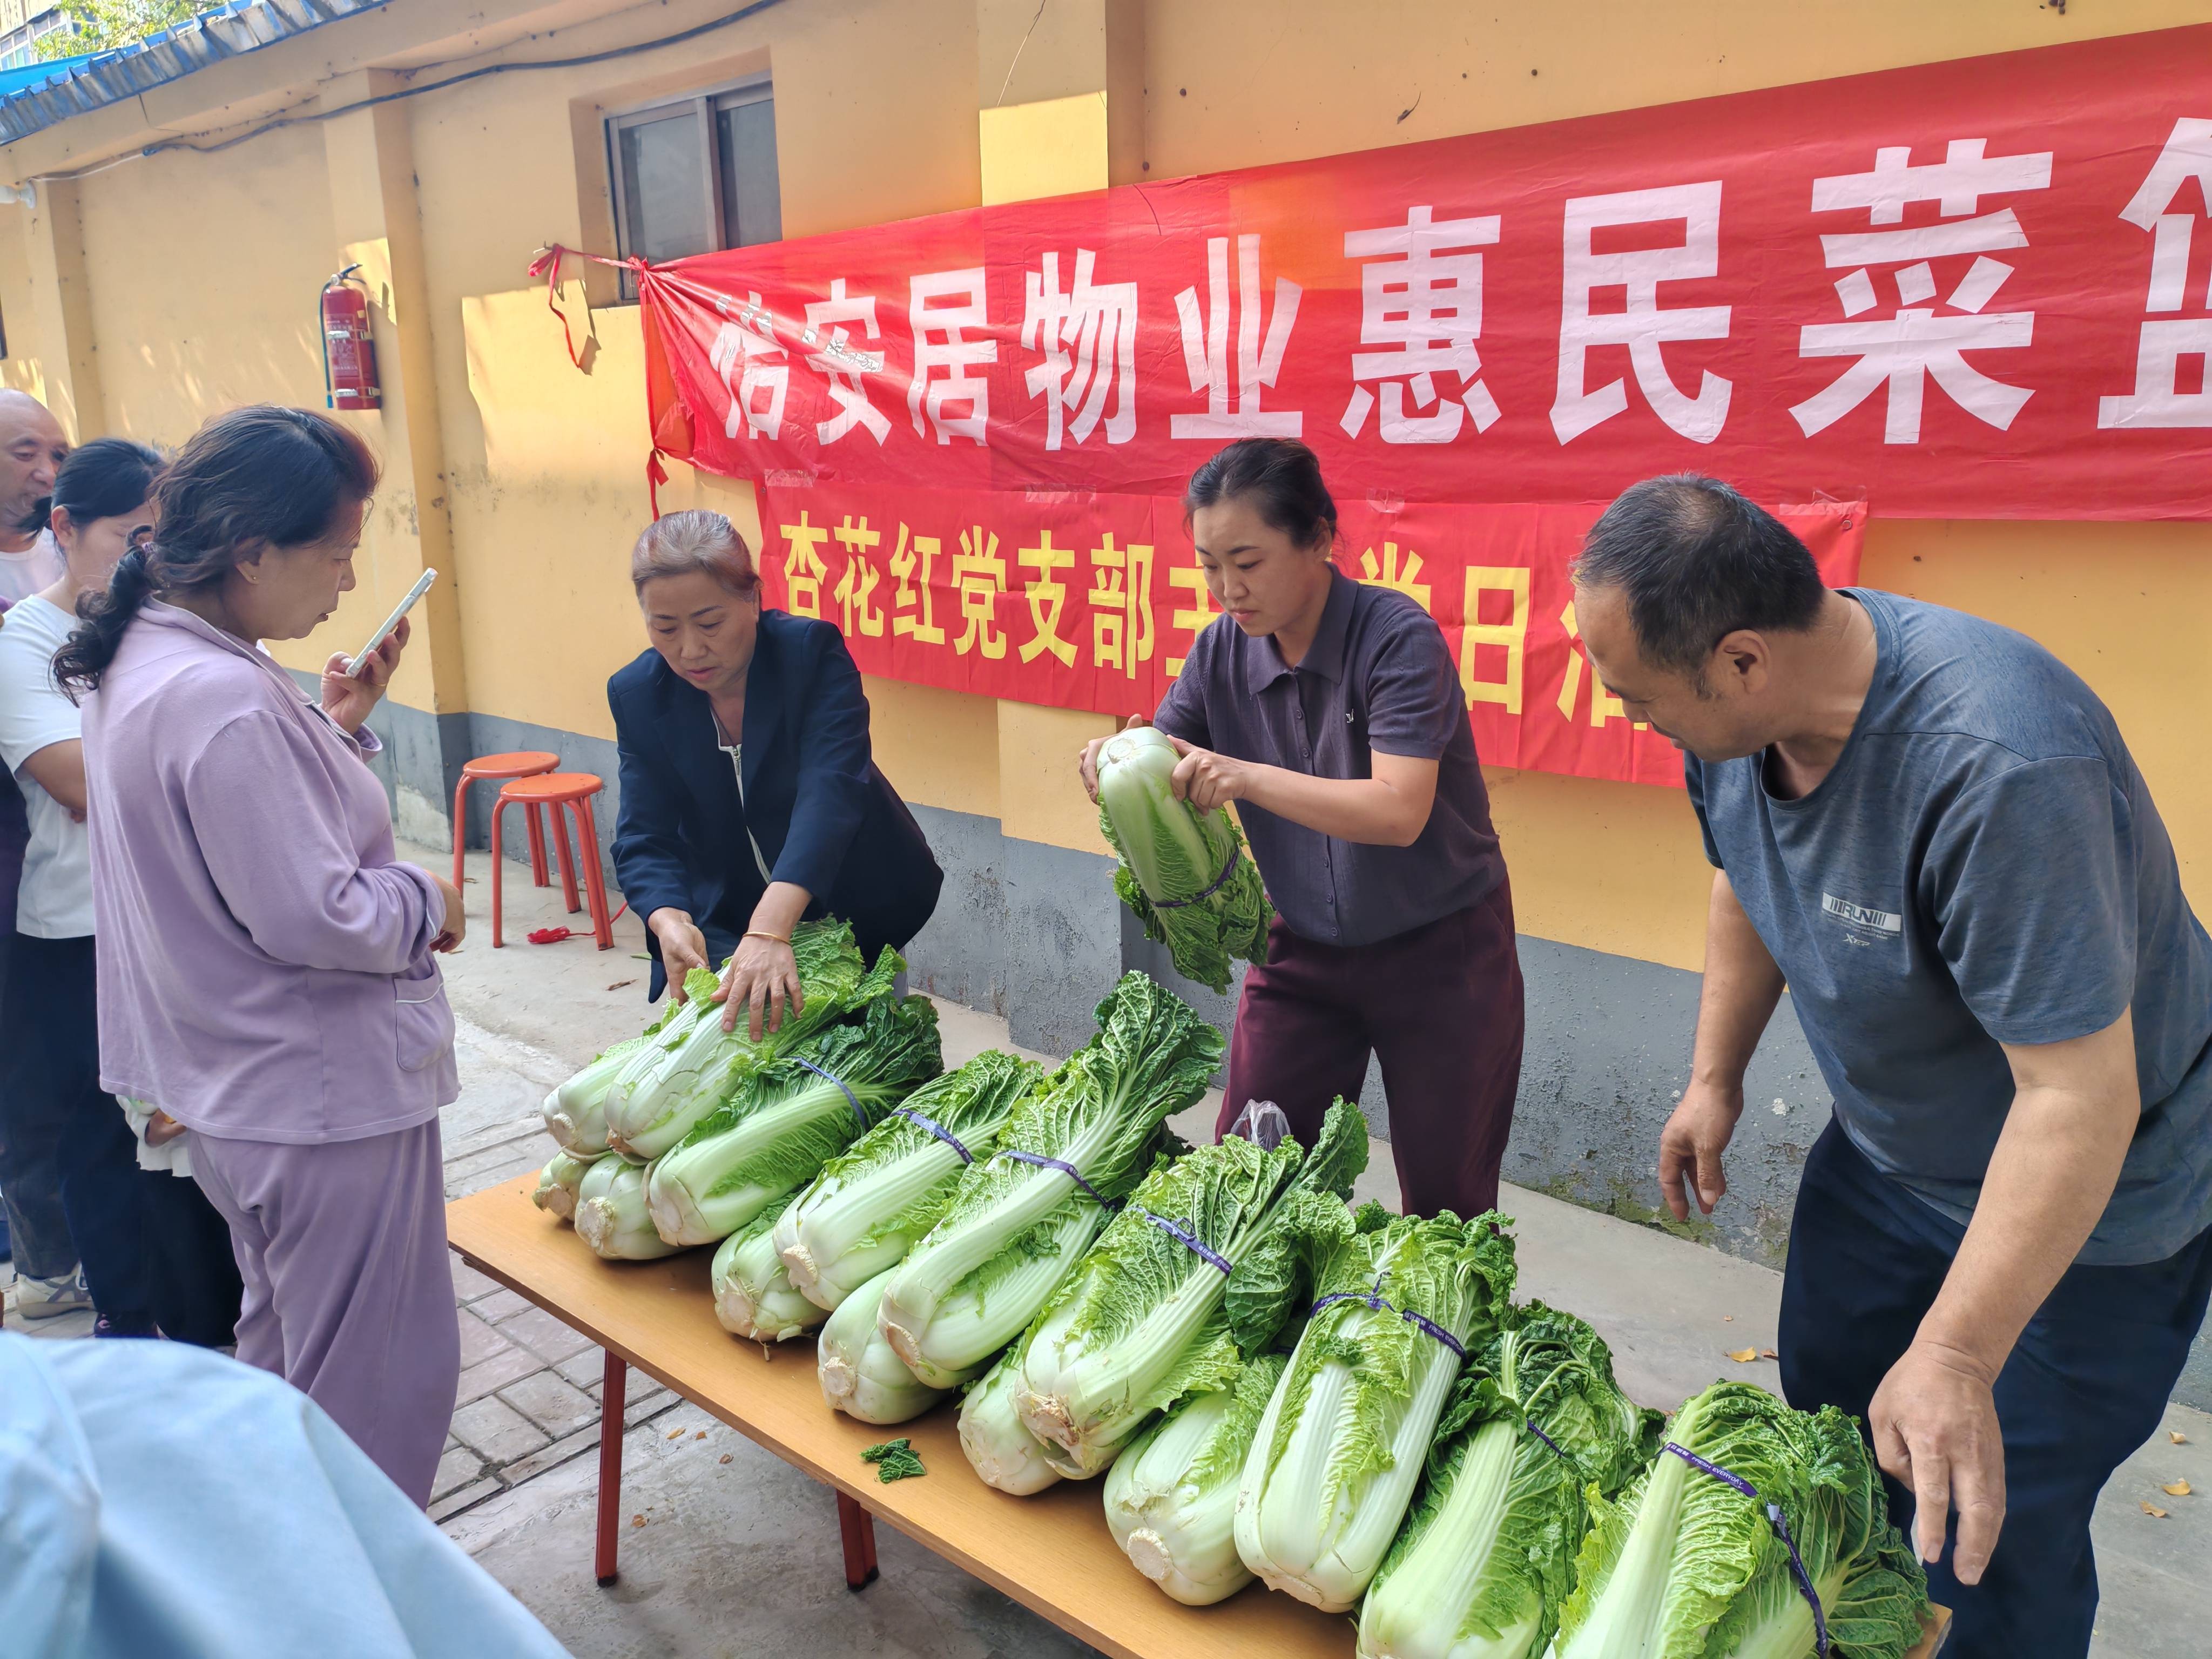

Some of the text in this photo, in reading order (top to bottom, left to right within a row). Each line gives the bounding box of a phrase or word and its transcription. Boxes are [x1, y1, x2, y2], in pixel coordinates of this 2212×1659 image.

[1428, 1324, 1445, 1338] FRESH
[1691, 1456, 1712, 1469] FRESH
[1712, 1467, 1744, 1486] EVERYDAY
